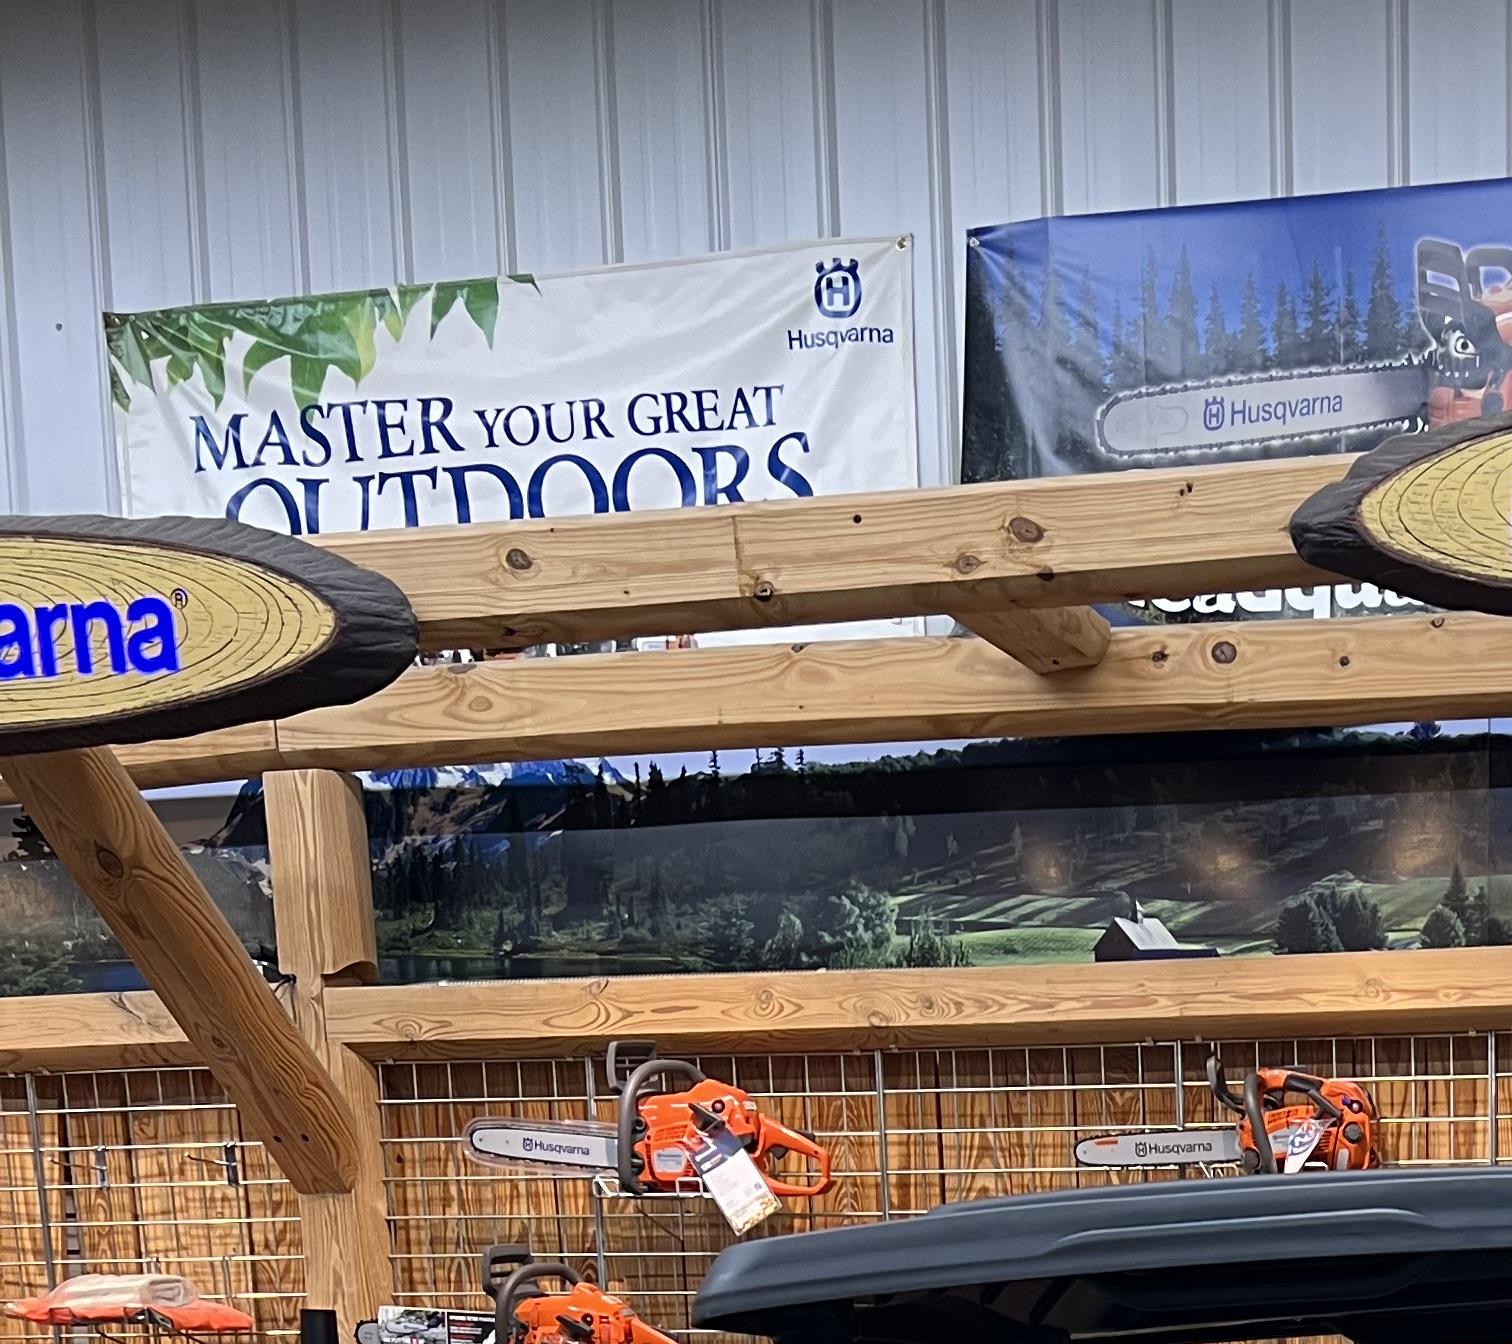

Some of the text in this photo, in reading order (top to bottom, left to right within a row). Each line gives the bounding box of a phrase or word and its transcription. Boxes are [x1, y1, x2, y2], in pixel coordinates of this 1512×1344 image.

[787, 327, 894, 351] Husqvarna
[1230, 391, 1343, 426] Husqvarna
[191, 384, 785, 473] MASTER YOUR GREAT
[533, 1140, 590, 1157] Husqvarna
[1148, 1138, 1213, 1157] Husqvarna
